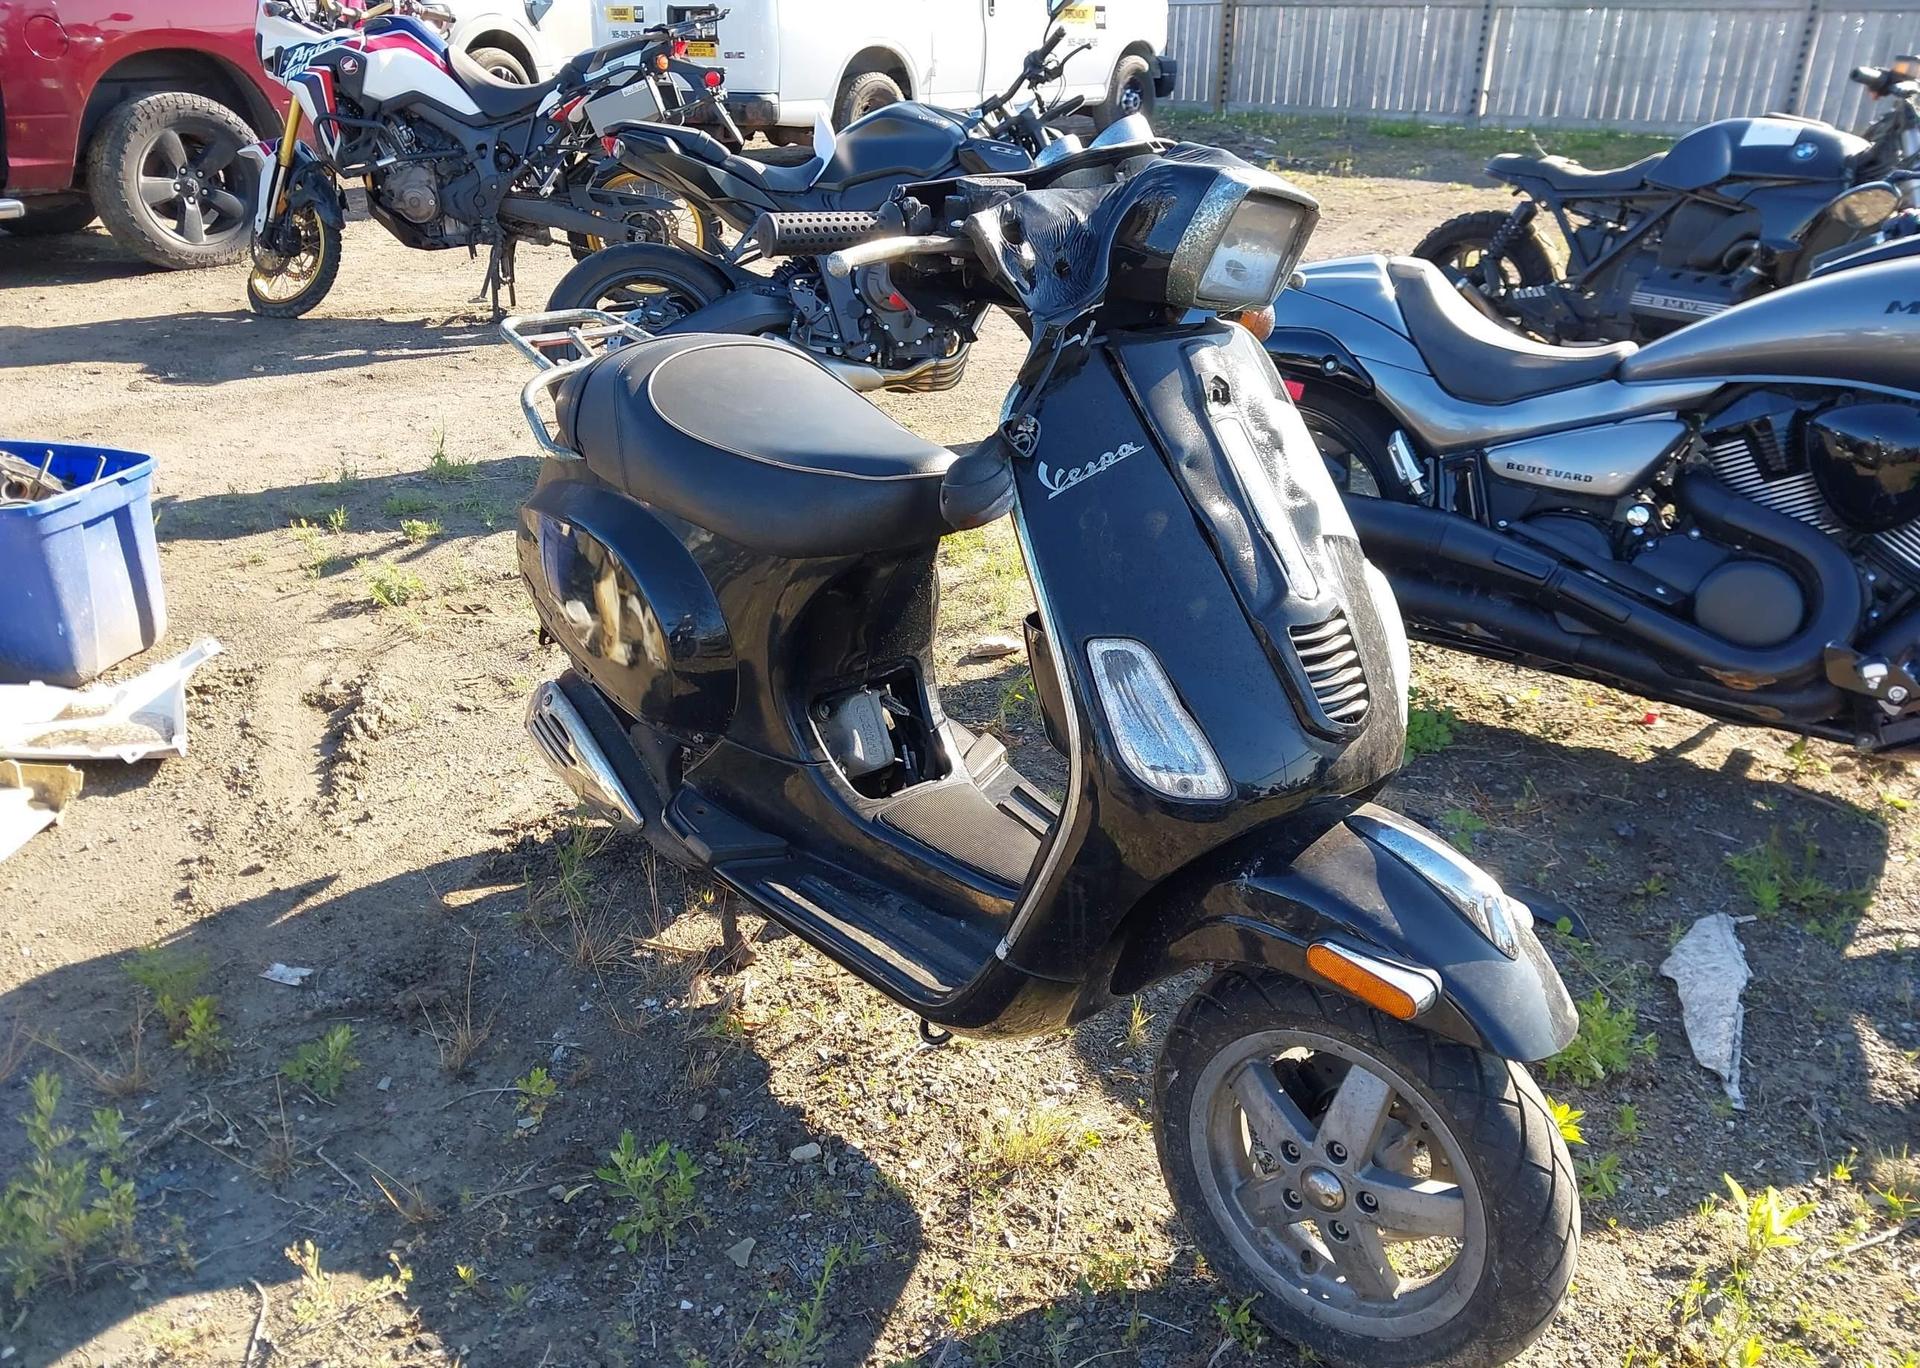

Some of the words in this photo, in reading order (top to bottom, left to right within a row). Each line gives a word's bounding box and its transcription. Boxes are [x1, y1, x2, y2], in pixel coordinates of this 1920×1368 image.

[724, 51, 745, 59] GMC
[1652, 296, 1697, 311] BMW
[1037, 441, 1145, 500] Vespa
[1506, 462, 1593, 483] BOULEVARD
